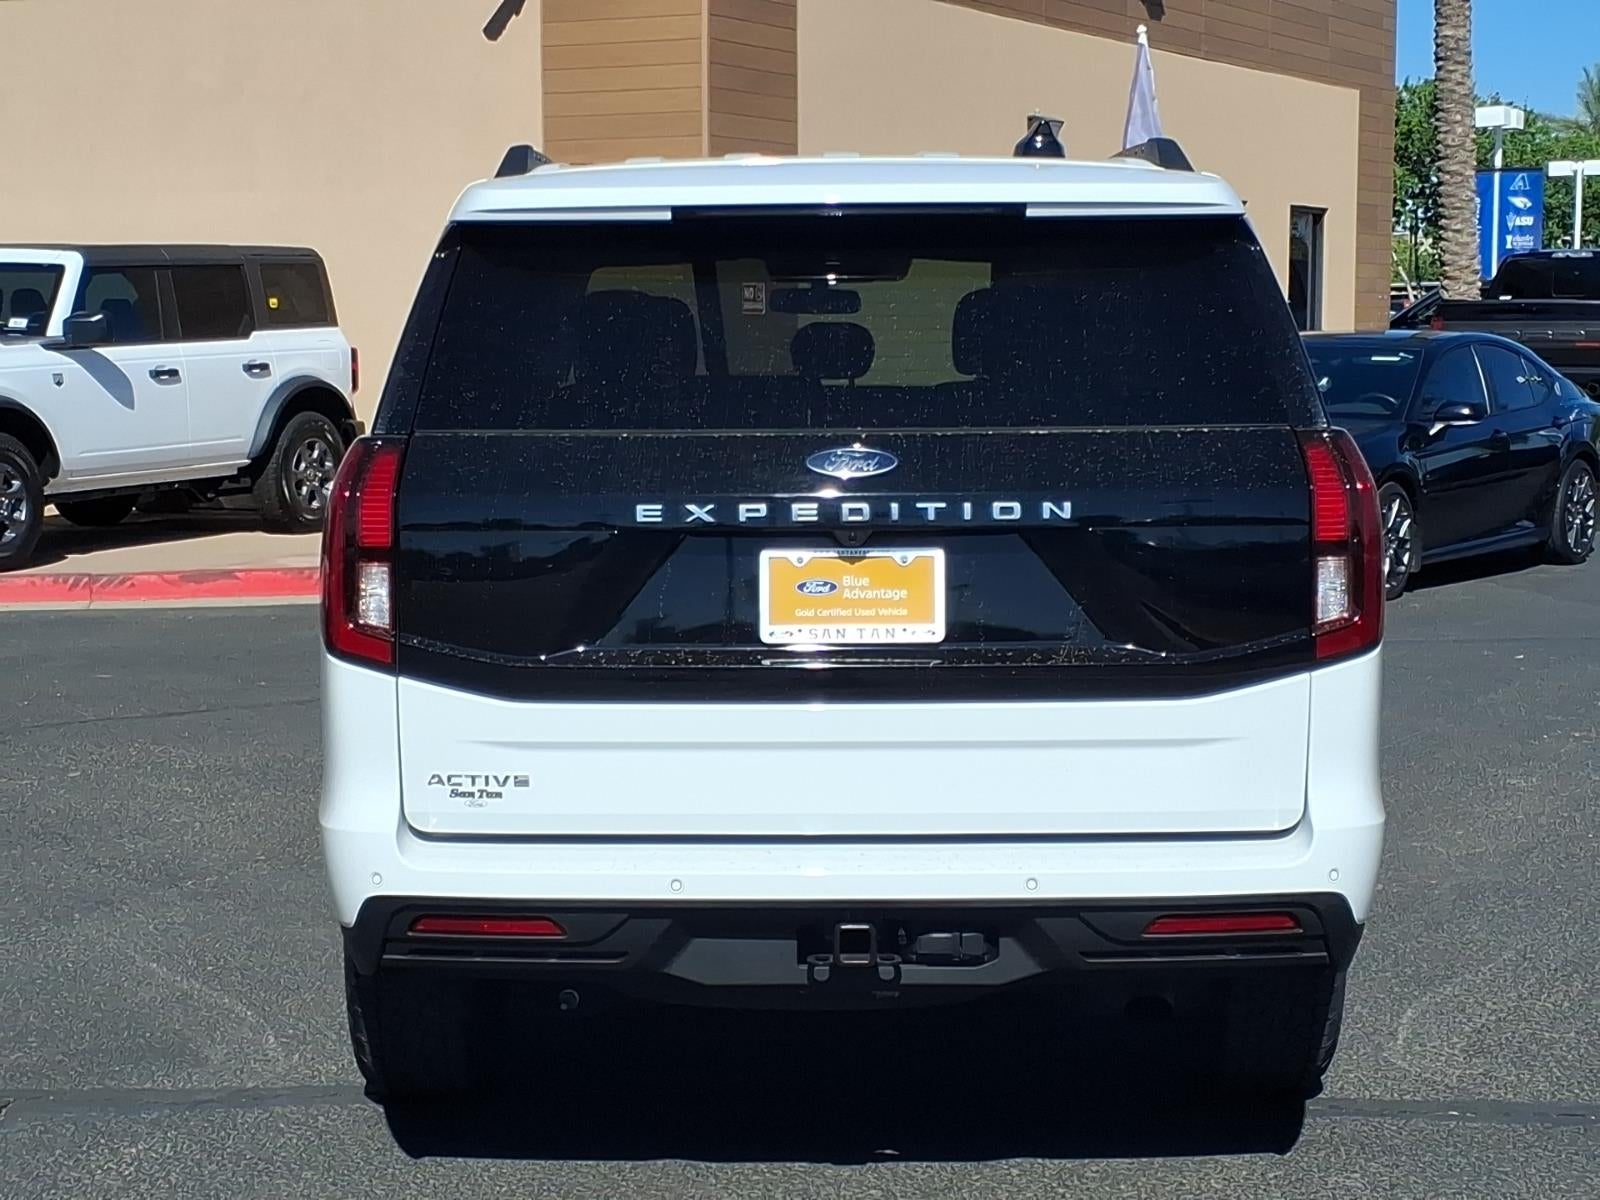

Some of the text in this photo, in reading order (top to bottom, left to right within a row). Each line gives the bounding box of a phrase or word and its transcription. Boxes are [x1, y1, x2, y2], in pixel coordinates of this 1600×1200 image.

[824, 451, 880, 472] Ford
[636, 502, 1072, 523] EXPEDITION
[842, 575, 870, 587] Blue
[842, 588, 908, 600] Advantage
[794, 608, 908, 617] Gold Certified Used Vehicle
[809, 627, 895, 639] SAN TAN
